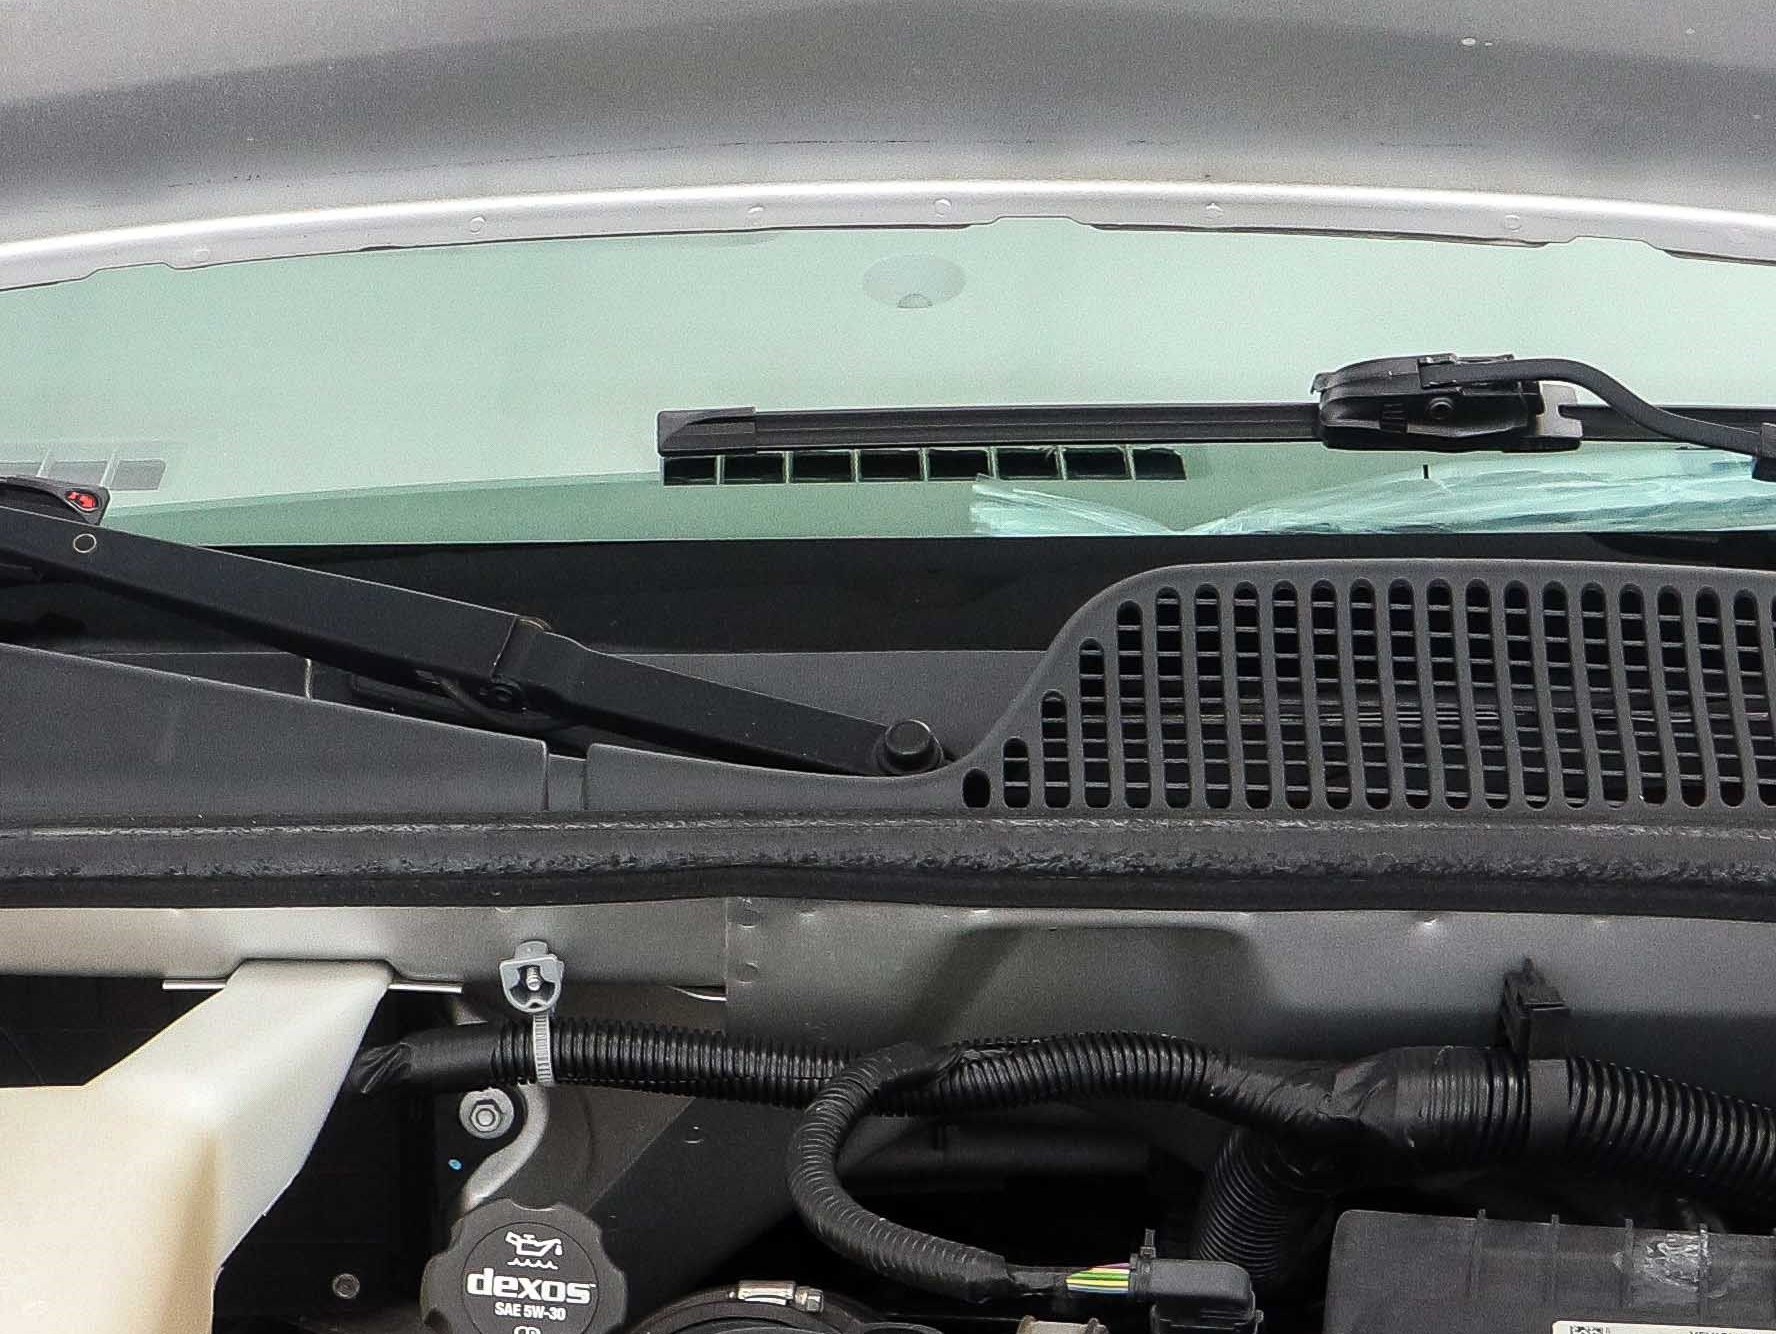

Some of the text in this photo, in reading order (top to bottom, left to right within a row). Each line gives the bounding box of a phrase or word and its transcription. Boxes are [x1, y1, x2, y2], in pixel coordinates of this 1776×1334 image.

[466, 1267, 591, 1304] dexos
[494, 1301, 566, 1321] SAE 5W-30
